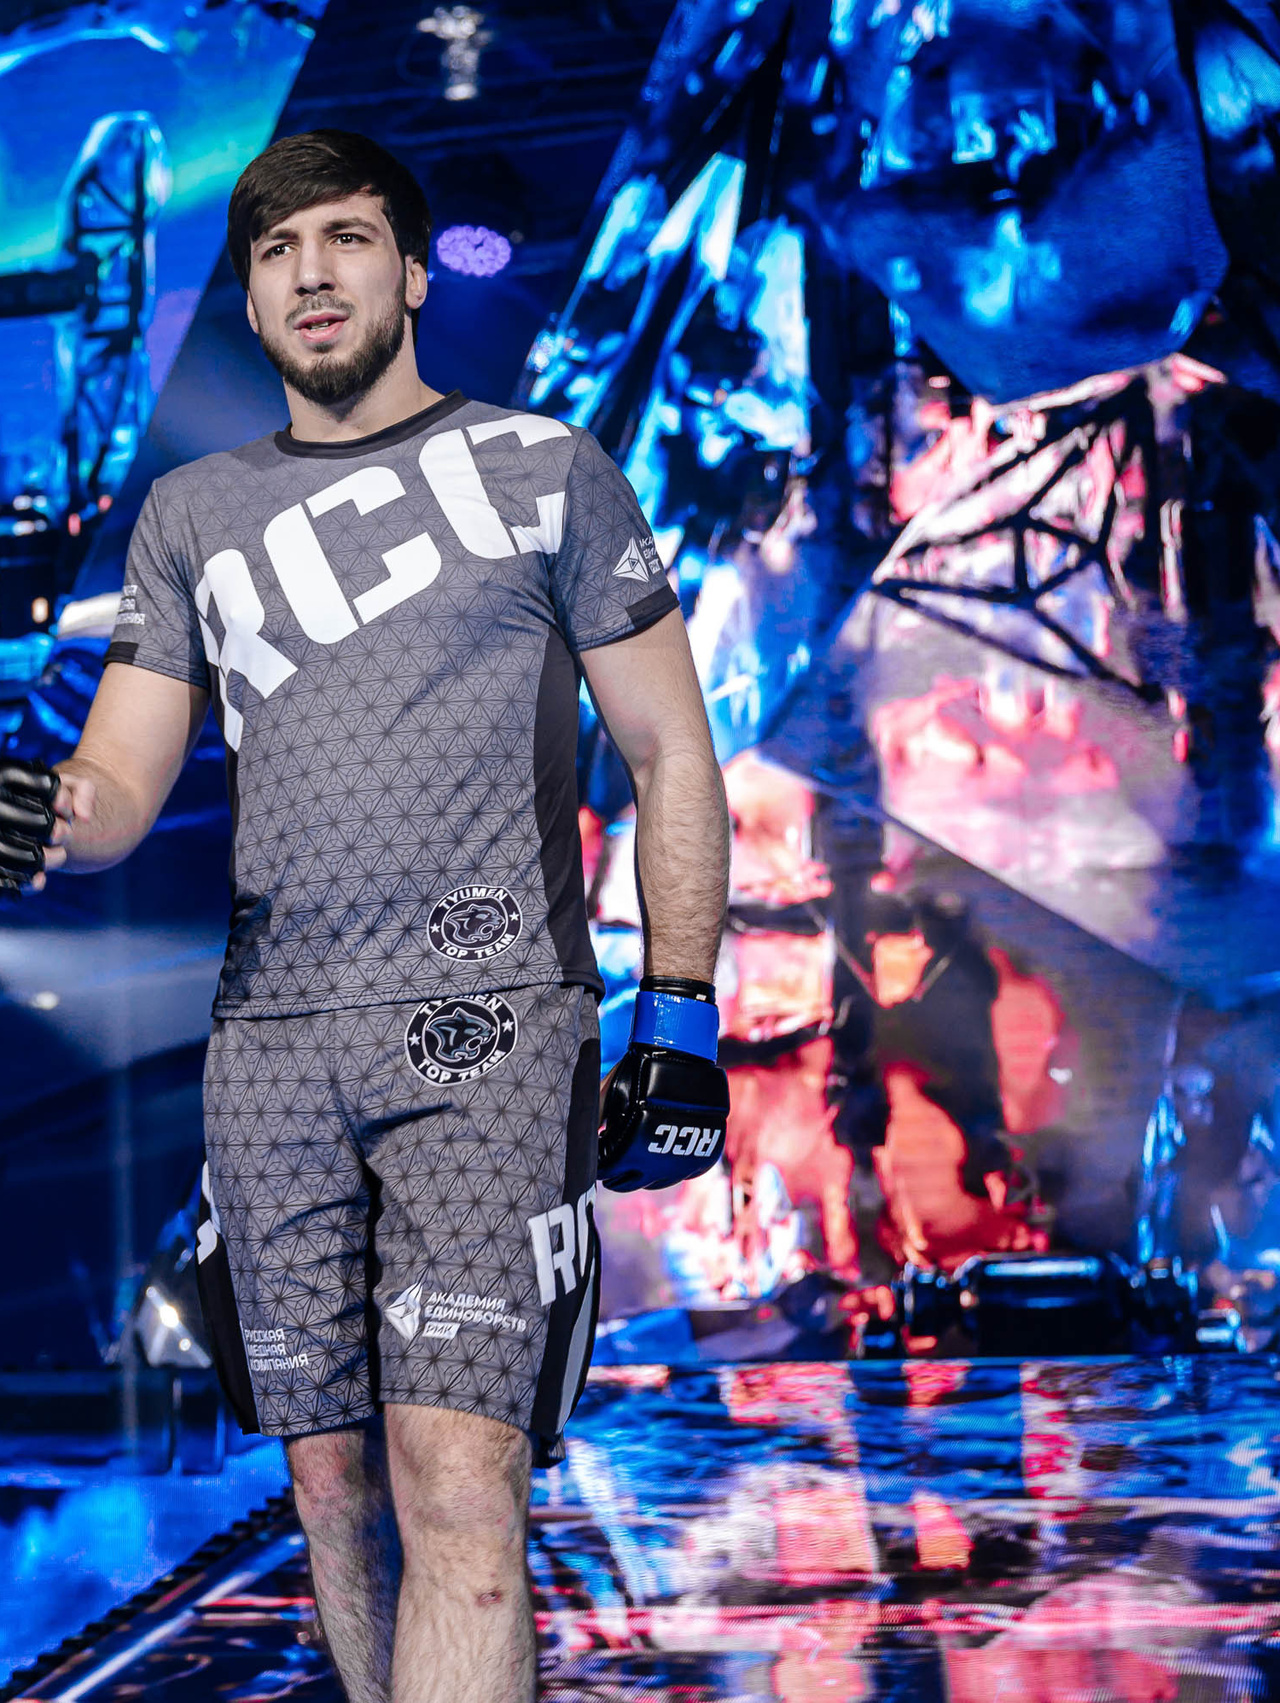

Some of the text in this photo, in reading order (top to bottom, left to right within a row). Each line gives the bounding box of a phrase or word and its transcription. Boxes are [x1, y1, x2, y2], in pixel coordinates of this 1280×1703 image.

[194, 414, 573, 752] RCC
[438, 886, 508, 910] TYUMEN
[439, 933, 515, 959] TOP TEAM
[417, 1049, 507, 1084] TOP TEAM
[648, 1124, 721, 1157] RCC
[425, 1291, 507, 1312] АКАДЕМИЯ
[424, 1305, 527, 1332] ЕДИНОБОРСТВ
